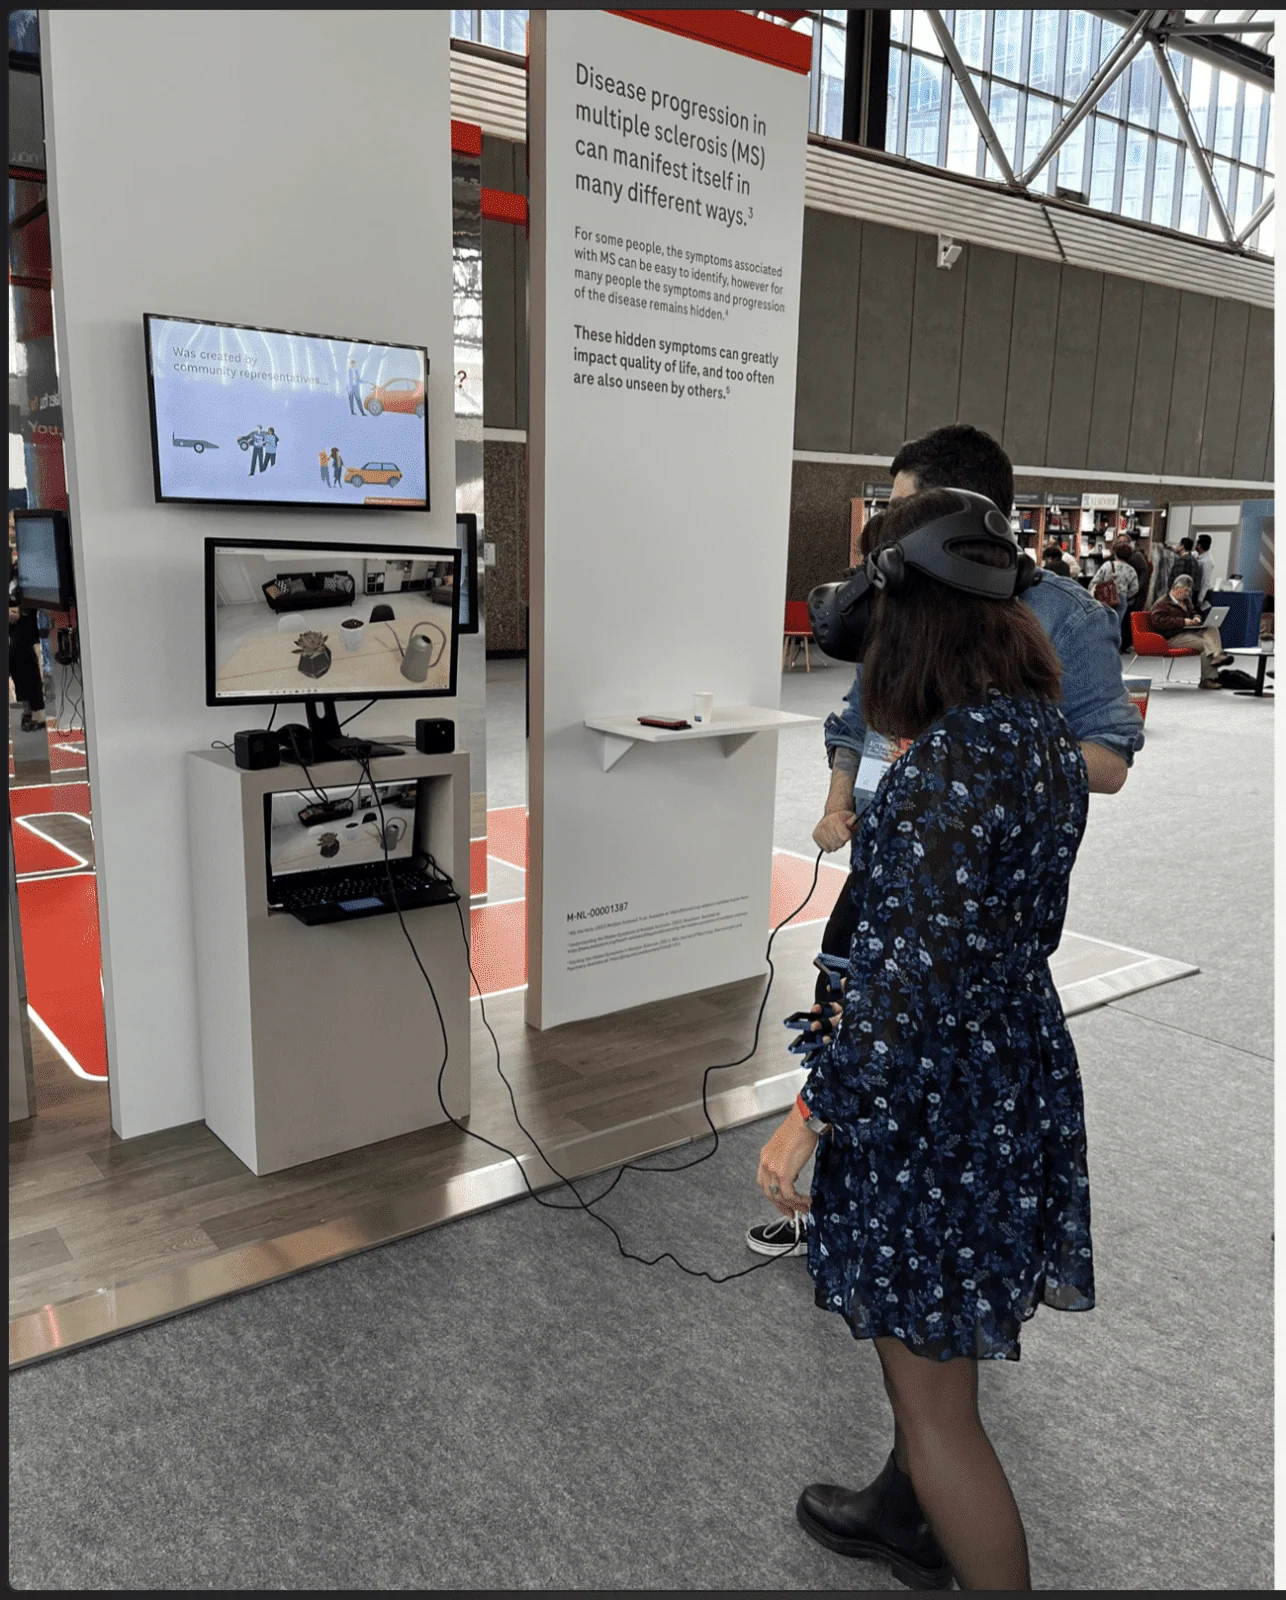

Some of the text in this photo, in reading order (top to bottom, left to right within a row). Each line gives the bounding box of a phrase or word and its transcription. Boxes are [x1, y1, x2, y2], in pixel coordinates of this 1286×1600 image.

[576, 62, 766, 135] Disease progression in
[576, 104, 766, 170] multiple sclerosis (MS)
[576, 139, 750, 195] can manifest itself in
[576, 174, 623, 203] many
[628, 182, 702, 216] different
[575, 226, 782, 277] For some people, the symptoms associated
[575, 249, 783, 295] with MS can be easy to identify, however for
[575, 268, 785, 313] many people the symptoms and progression
[575, 287, 585, 298] of
[588, 289, 605, 301] the
[608, 292, 647, 308] disease
[650, 299, 688, 316] remains
[172, 346, 257, 367] Was created by
[574, 325, 778, 368] These hidden symptoms can greatly
[574, 347, 774, 384] impact quality of life, and too often
[174, 363, 237, 378] community
[574, 371, 594, 384] are
[597, 373, 623, 389] also
[626, 379, 668, 393] unseen
[671, 381, 684, 397] by
[567, 902, 628, 922] M-NL-00001387
